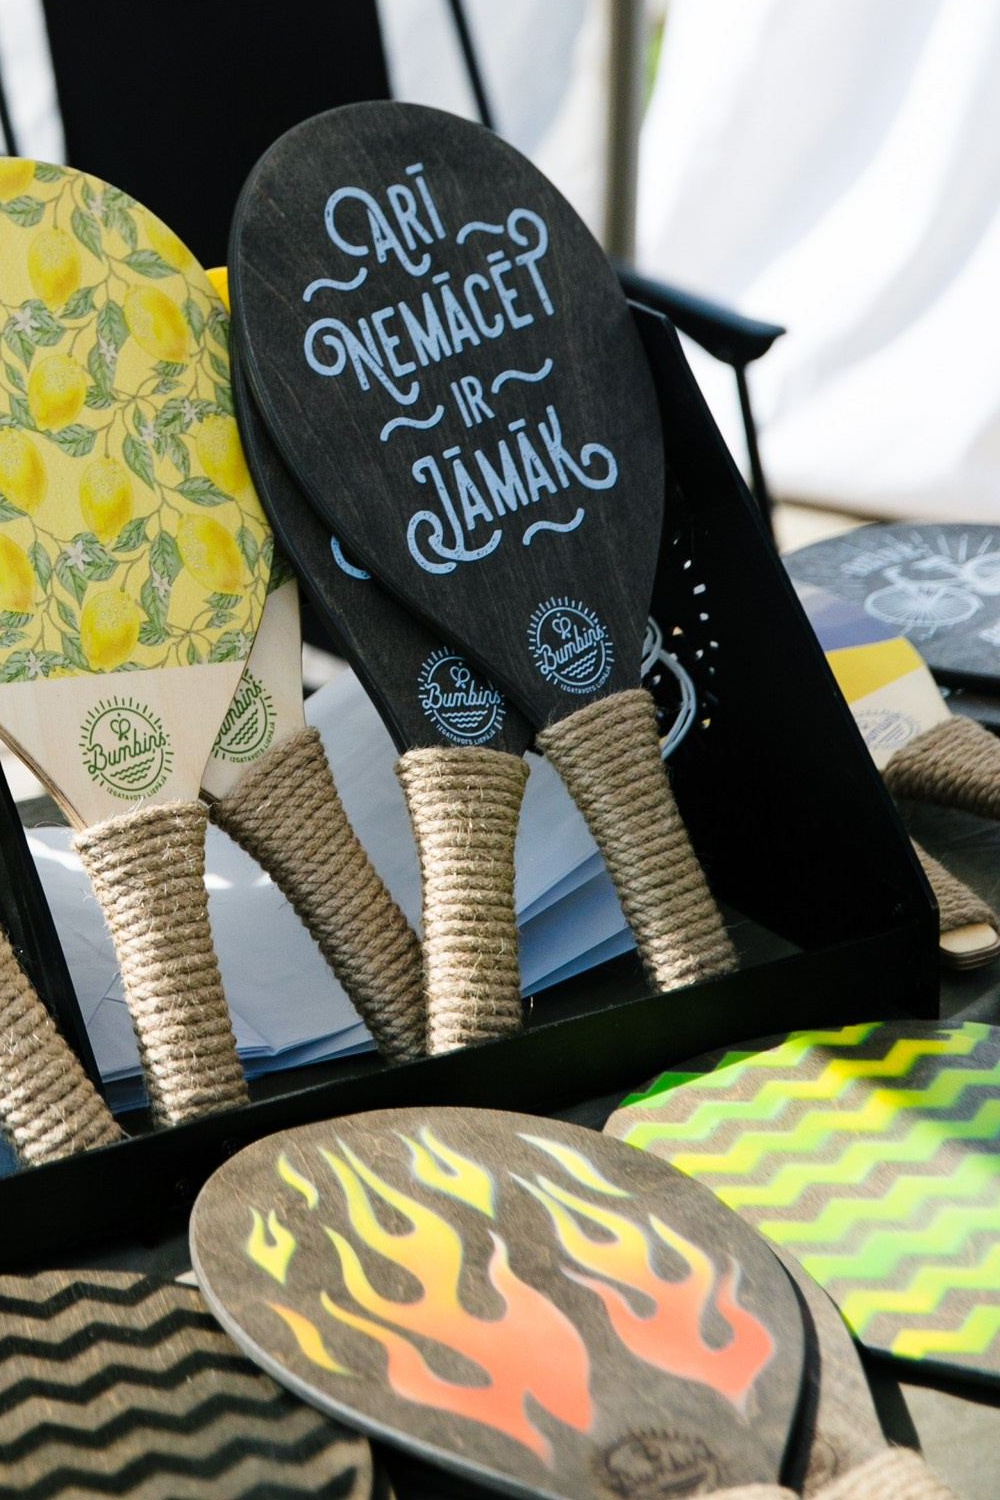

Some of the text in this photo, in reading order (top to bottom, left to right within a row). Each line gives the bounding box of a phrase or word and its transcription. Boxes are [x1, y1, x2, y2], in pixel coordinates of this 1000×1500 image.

[324, 162, 447, 277] ARĪ
[303, 207, 555, 406] NEMĀCĒT
[450, 375, 496, 428] IR
[406, 404, 619, 575] JĀMĀK
